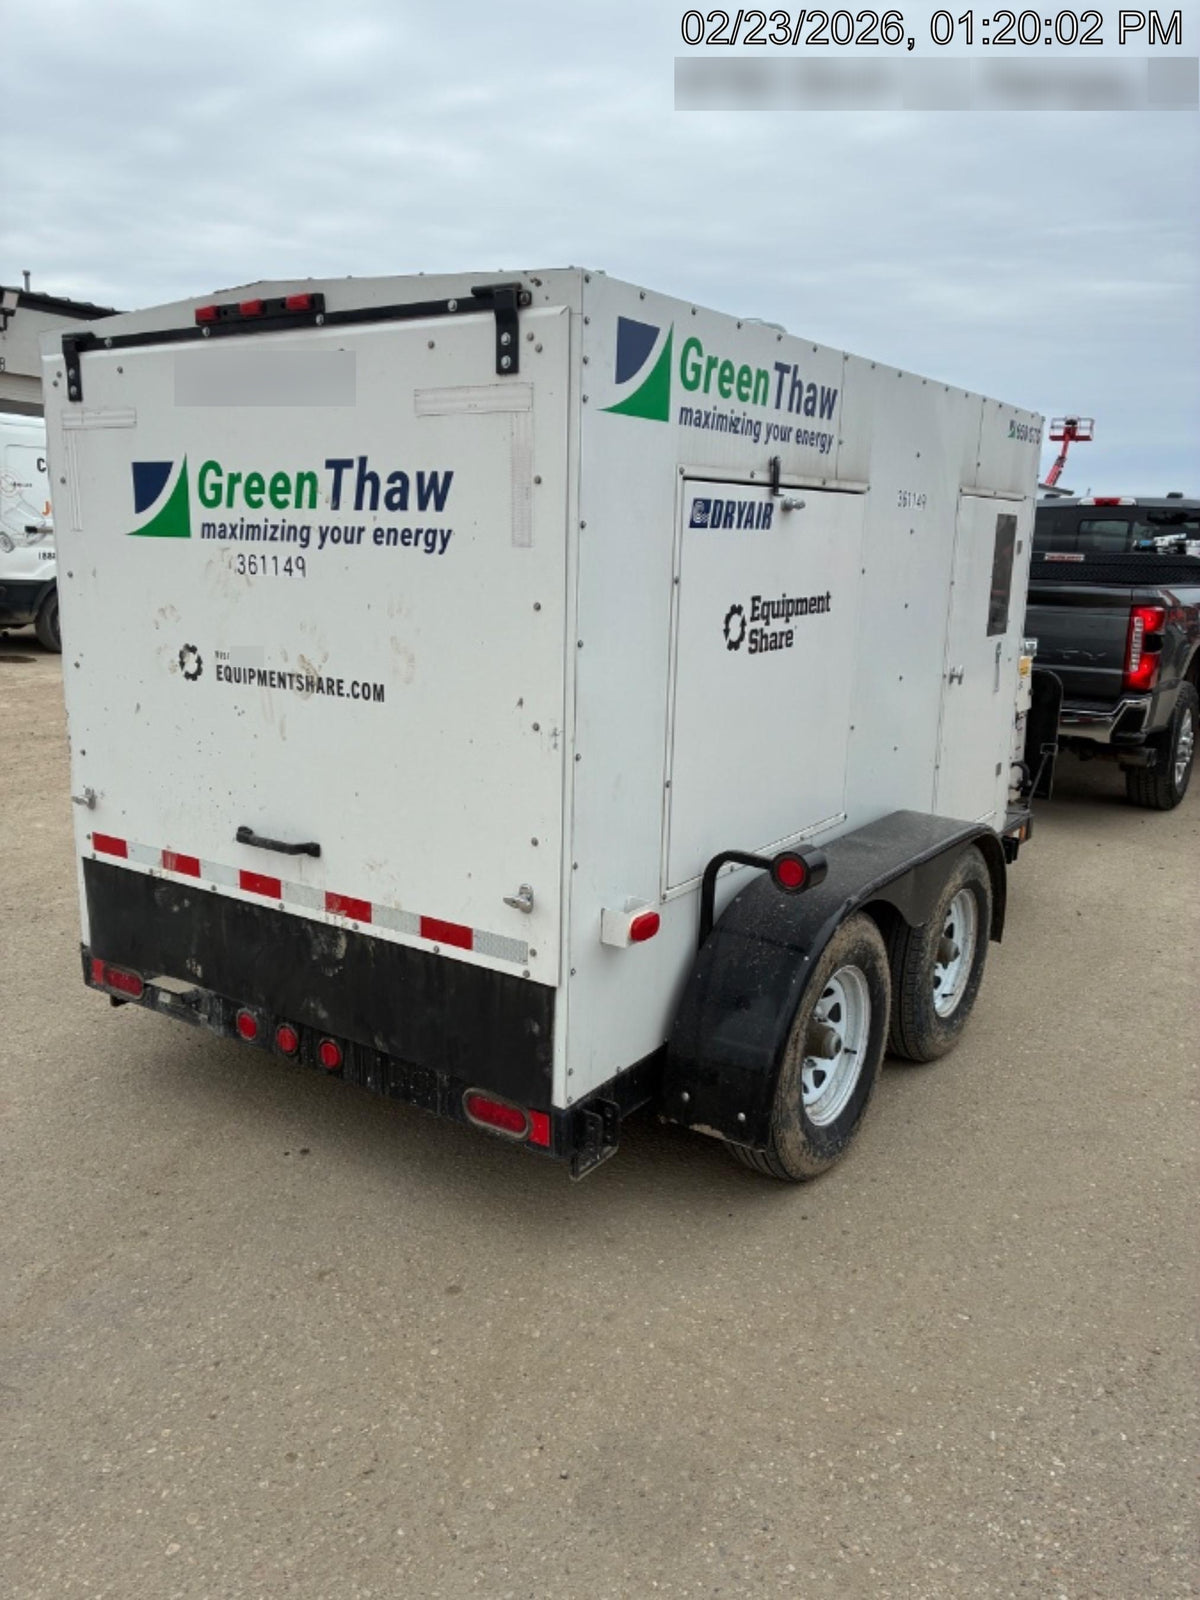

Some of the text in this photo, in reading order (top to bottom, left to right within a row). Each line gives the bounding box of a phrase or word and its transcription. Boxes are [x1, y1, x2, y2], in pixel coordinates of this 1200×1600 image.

[678, 405, 835, 455] maximizing your energy
[709, 499, 775, 530] DRYAIR
[201, 518, 453, 555] maximizing your energy
[236, 554, 306, 577] 361149
[750, 590, 831, 626] Equipment
[748, 628, 794, 654] Share
[216, 664, 385, 702] EQUIPMENTSHARE.COM
